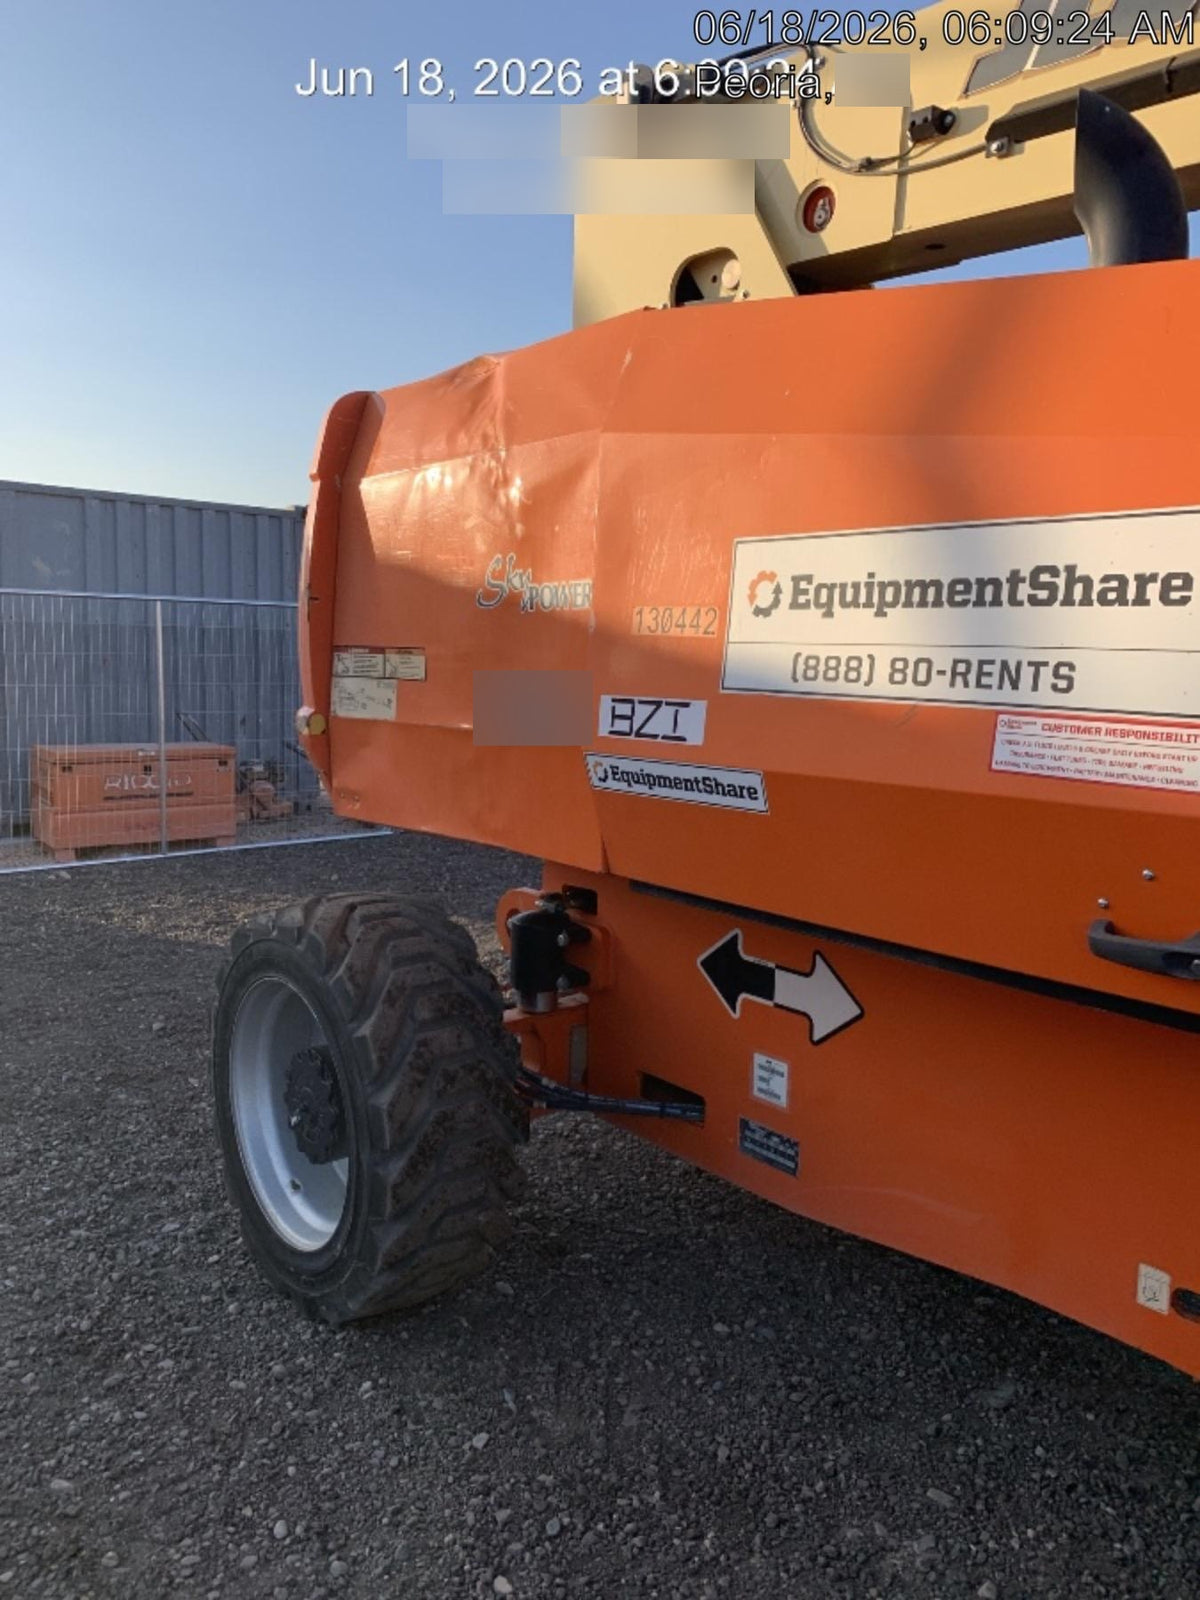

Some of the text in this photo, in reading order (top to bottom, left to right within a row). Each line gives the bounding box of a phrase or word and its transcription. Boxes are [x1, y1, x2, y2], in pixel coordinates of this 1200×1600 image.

[788, 564, 1194, 618] EquipmentShare
[635, 607, 718, 635] 130442
[791, 652, 1076, 694] (888) 80-RENTS
[608, 697, 691, 742] BZI
[1041, 723, 1102, 737] CUSTOMER
[608, 764, 760, 801] EquipmentShare
